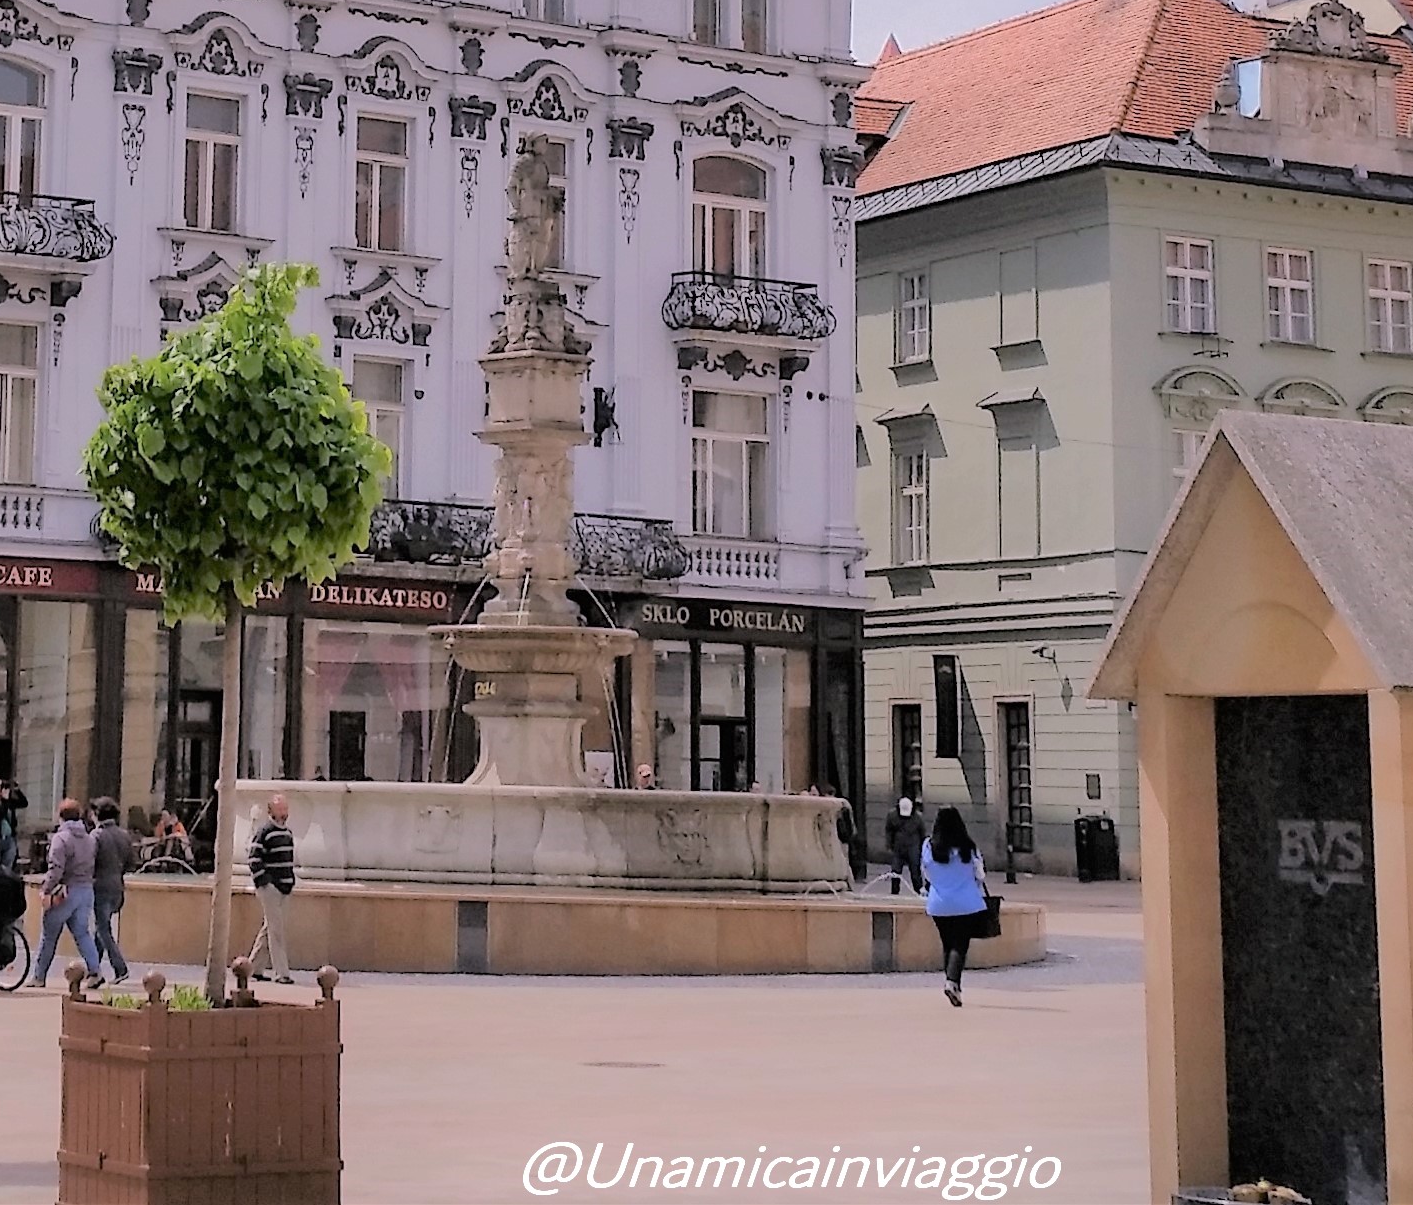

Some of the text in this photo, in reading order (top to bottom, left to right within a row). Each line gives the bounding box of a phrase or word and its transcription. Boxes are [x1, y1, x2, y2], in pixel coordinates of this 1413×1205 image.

[310, 584, 448, 609] DELIKATESO
[642, 603, 805, 632] SKLO PORCELÁN
[1277, 819, 1364, 872] BVS
